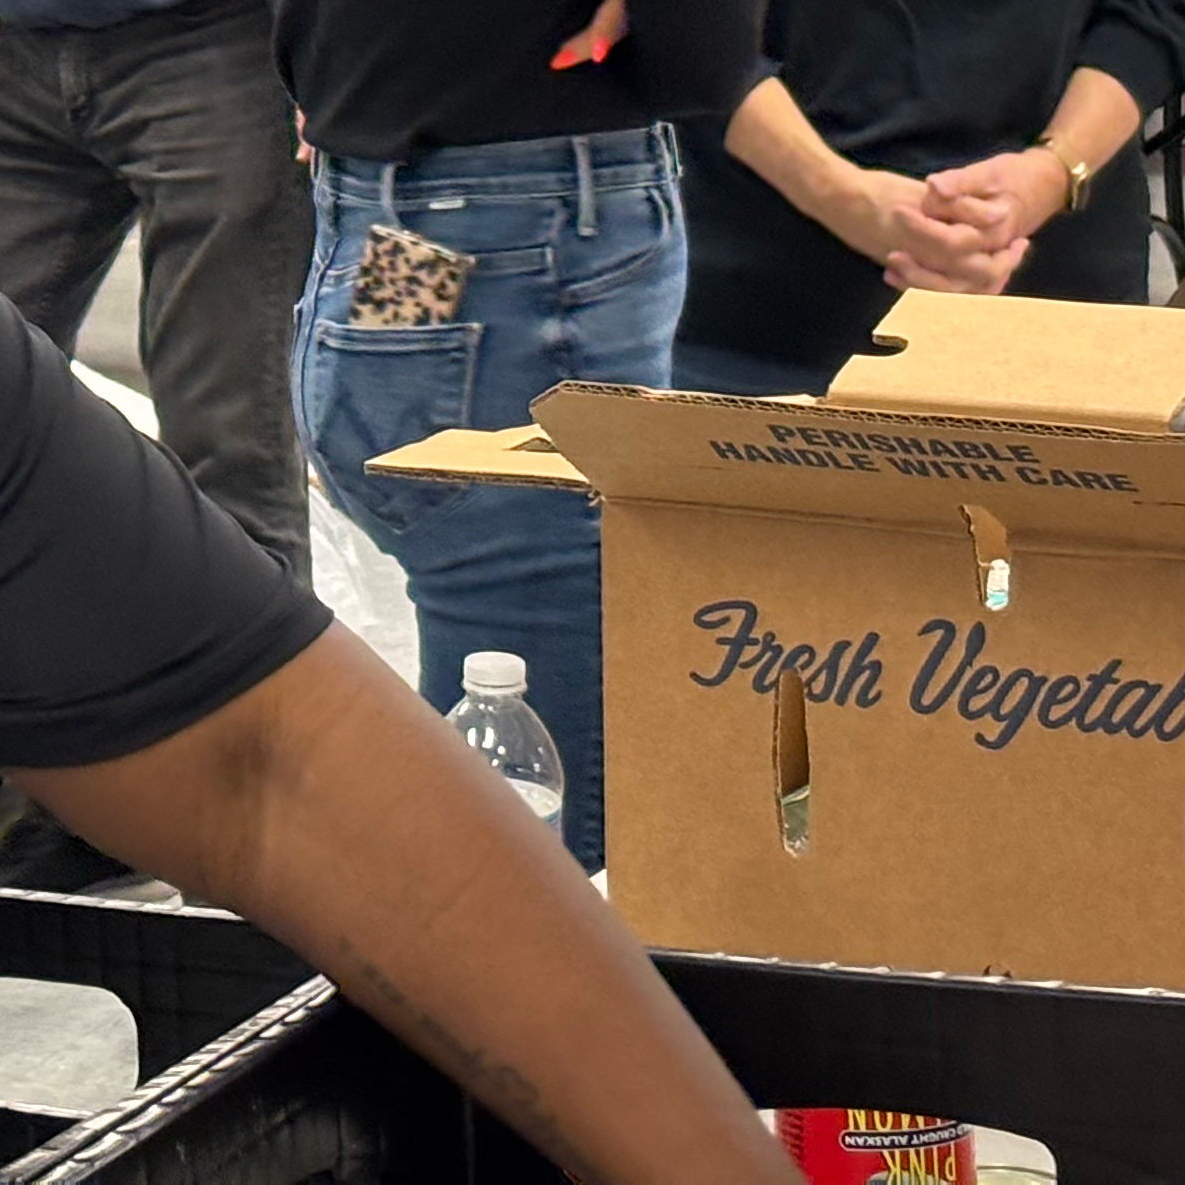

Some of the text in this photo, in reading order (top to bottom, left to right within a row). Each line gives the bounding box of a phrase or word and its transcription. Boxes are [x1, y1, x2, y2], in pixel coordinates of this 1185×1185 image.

[767, 423, 1041, 465] PERISHABLE
[709, 440, 1139, 493] HANDLE WITH CARE
[689, 599, 883, 708] Fresh
[845, 1134, 909, 1147] ALASKAN
[881, 1141, 957, 1185] PINK
